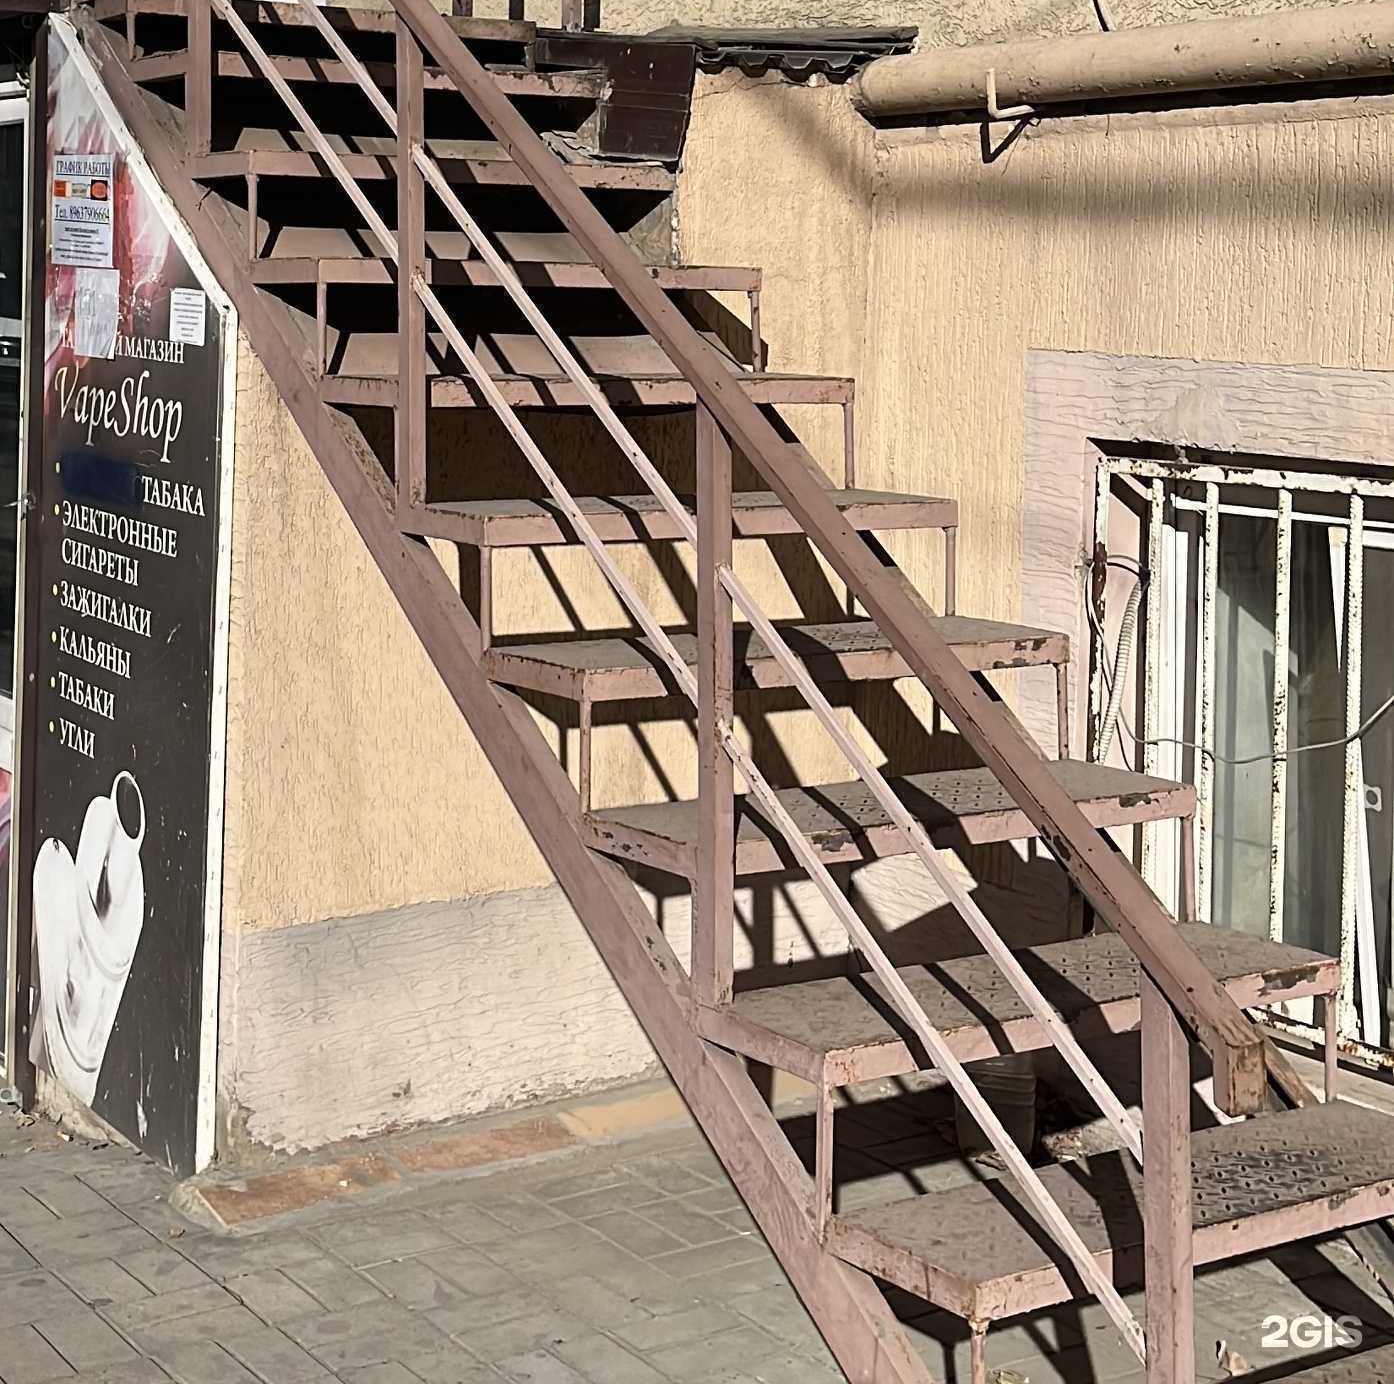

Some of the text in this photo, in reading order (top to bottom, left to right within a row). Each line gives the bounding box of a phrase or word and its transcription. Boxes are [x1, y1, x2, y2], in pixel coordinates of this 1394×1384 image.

[56, 160, 111, 175] ГРАФИК РАБОТЫ
[125, 336, 185, 364] МАГАЗИН
[54, 362, 183, 463] VapeShop
[141, 475, 206, 517] ТАБАКА
[62, 500, 177, 558] ЭЛЕКТРОННЫЕ
[61, 538, 140, 587] СИГАРЕТЫ
[60, 580, 152, 638] ЗАЖИГАЛКИ
[59, 626, 132, 679] КАЛЬЯНЫ
[58, 671, 116, 721] ТАБАКИ
[59, 718, 96, 760] УГЛИ
